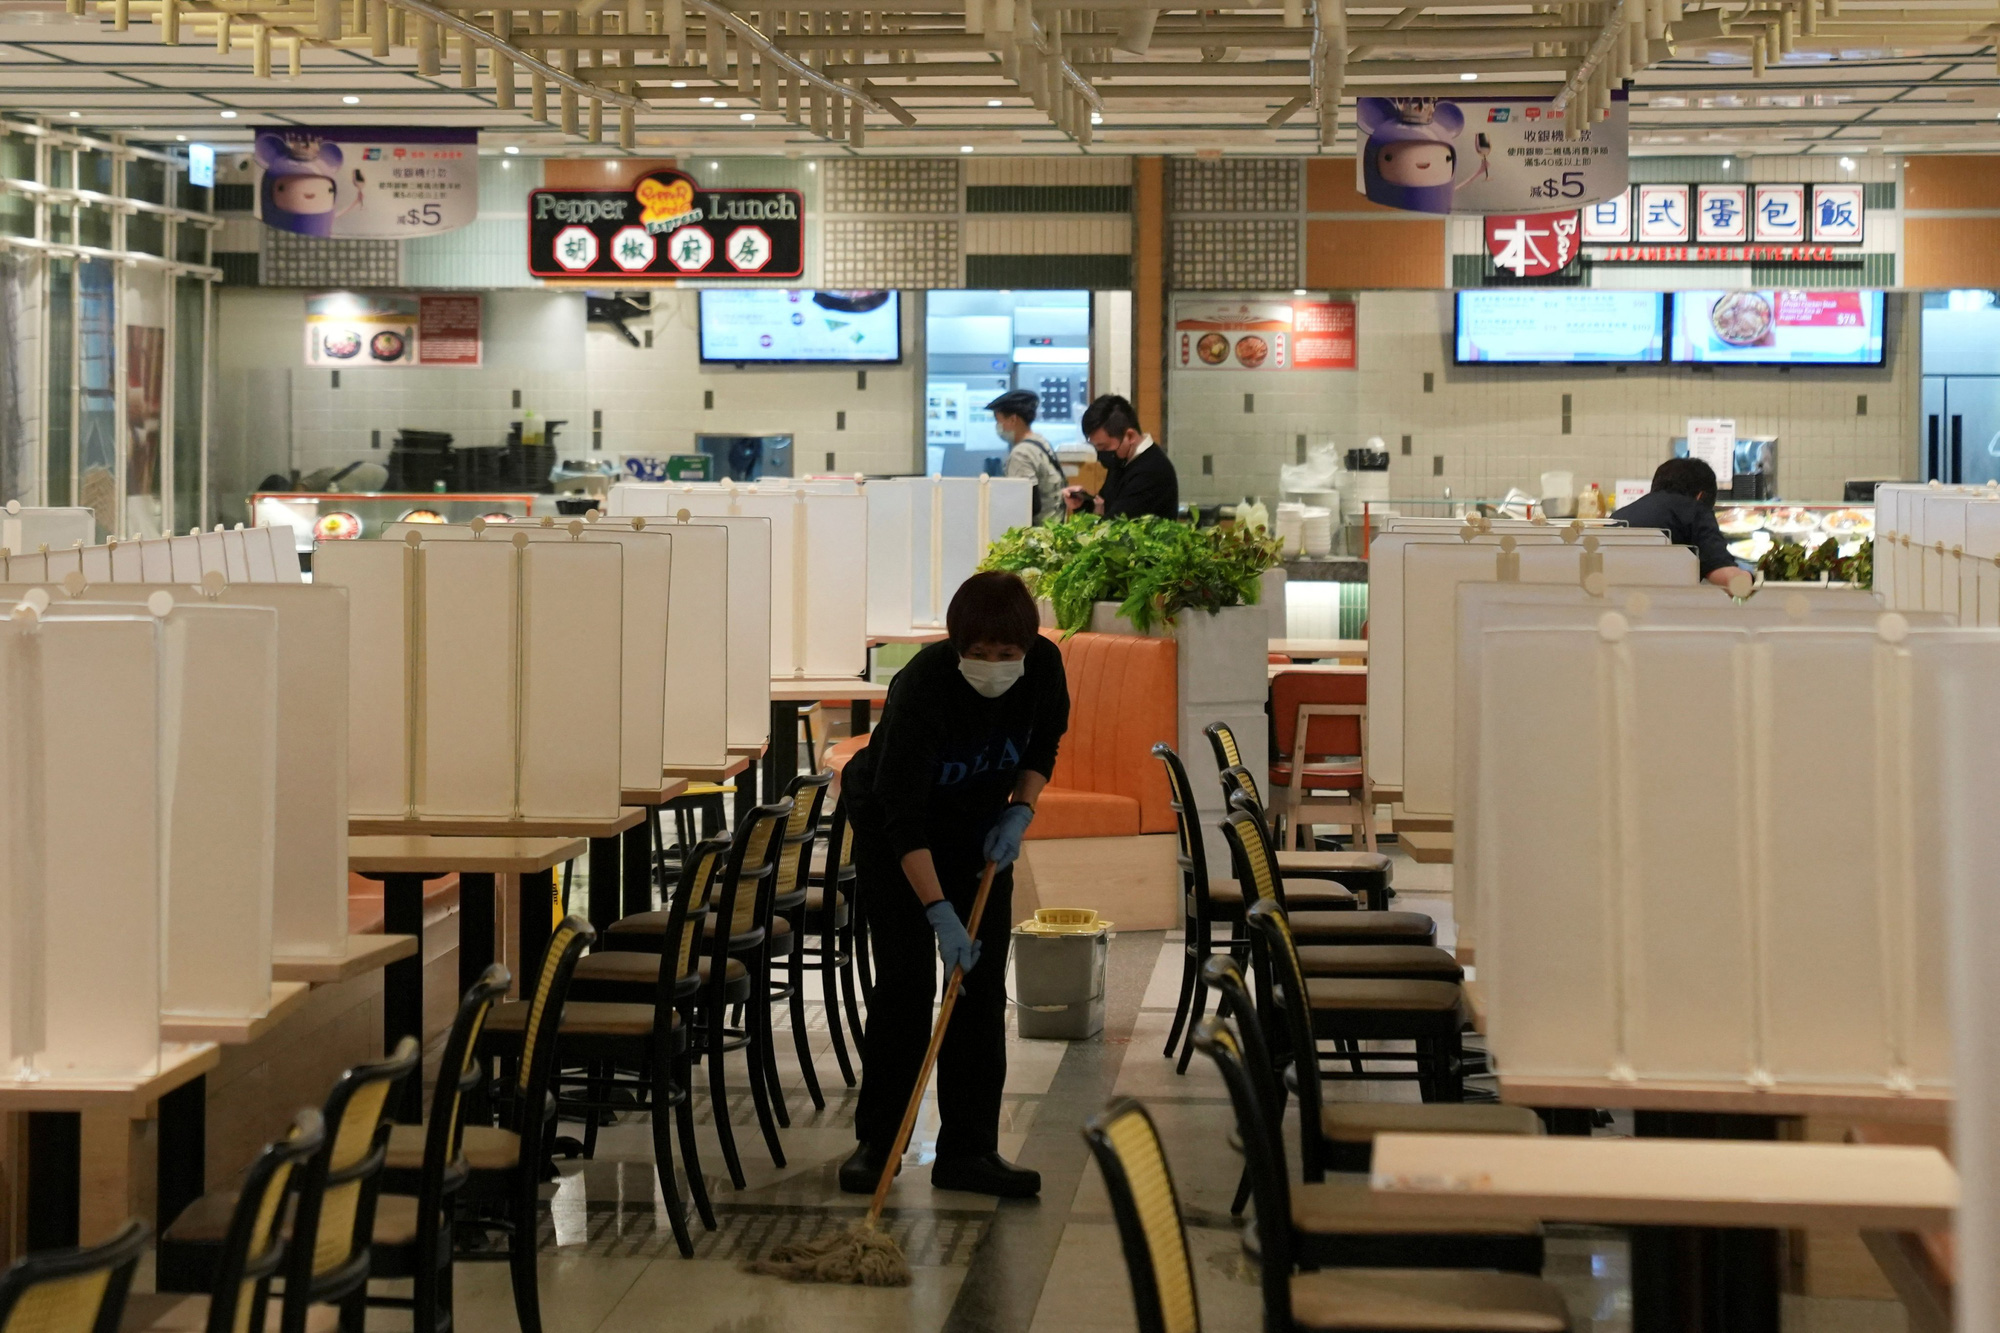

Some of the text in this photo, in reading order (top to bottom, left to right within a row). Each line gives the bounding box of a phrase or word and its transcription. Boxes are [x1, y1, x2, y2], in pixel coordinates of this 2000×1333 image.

[1524, 130, 1592, 143] 收銀機款
[535, 194, 797, 223] Pepper Lunch
[1596, 198, 1856, 228] 日式蛋包飯
[564, 235, 759, 263] 胡椒廚房
[1494, 218, 1551, 277] 本
[1604, 246, 1833, 261] JAPANESE OMELETTE RICE
